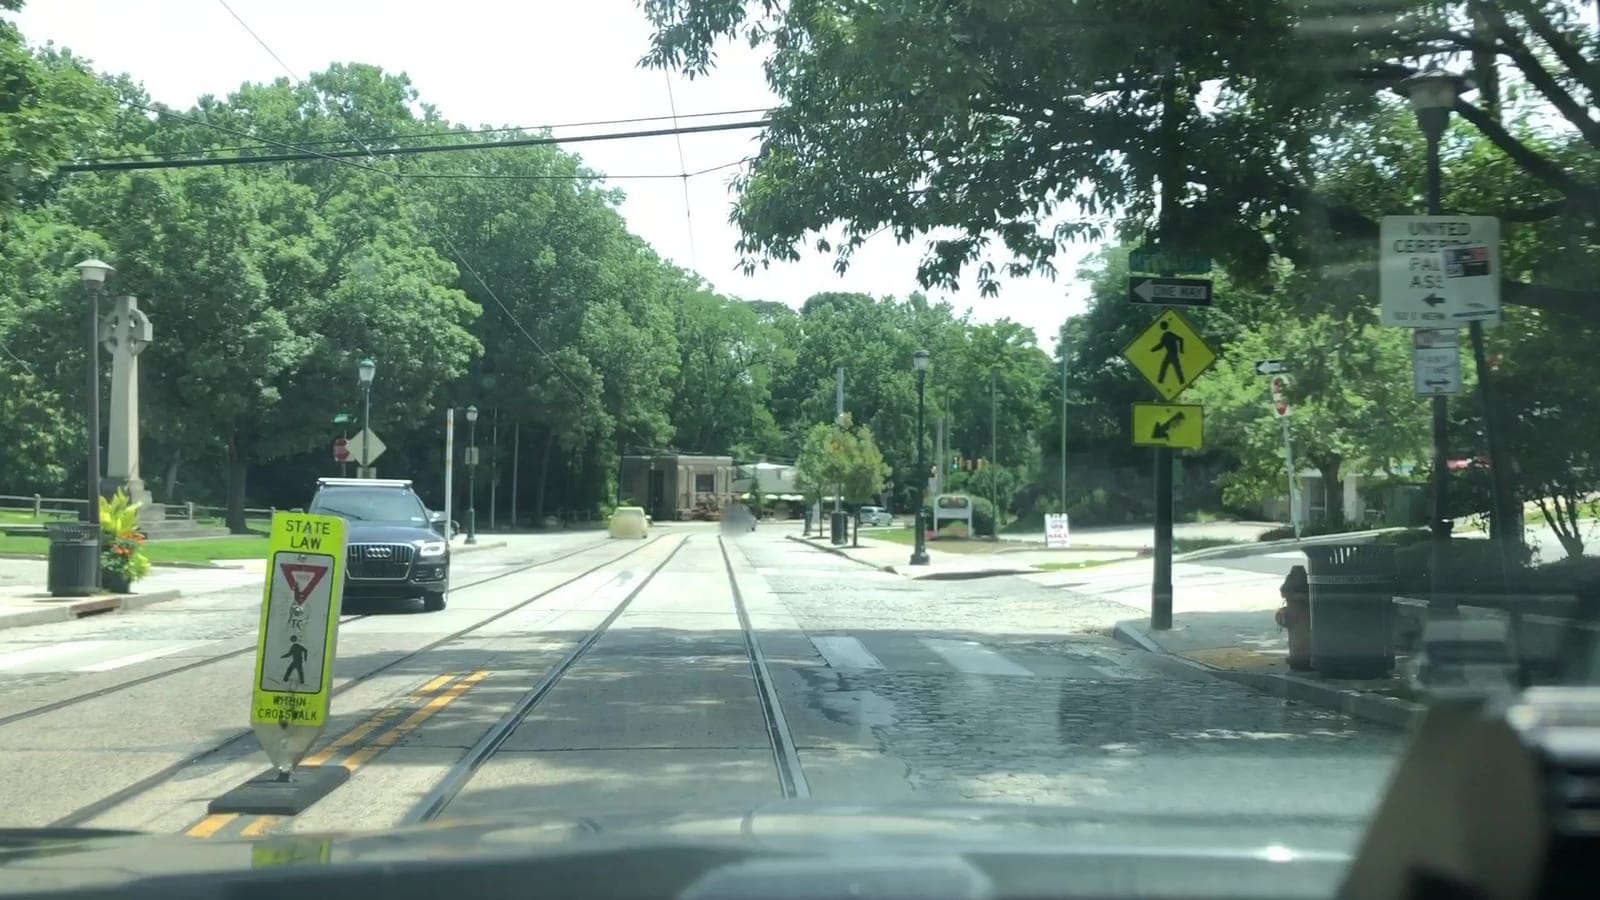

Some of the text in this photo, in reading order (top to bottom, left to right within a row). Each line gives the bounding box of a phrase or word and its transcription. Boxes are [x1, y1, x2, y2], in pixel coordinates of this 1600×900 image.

[1407, 222, 1471, 236] UNITED
[1393, 239, 1481, 253] CERE
[1153, 285, 1176, 297] ONE
[286, 519, 331, 535] STATE
[291, 536, 321, 550] LAW
[273, 695, 307, 706] WITHIN
[257, 707, 318, 721] CROSSWALK
